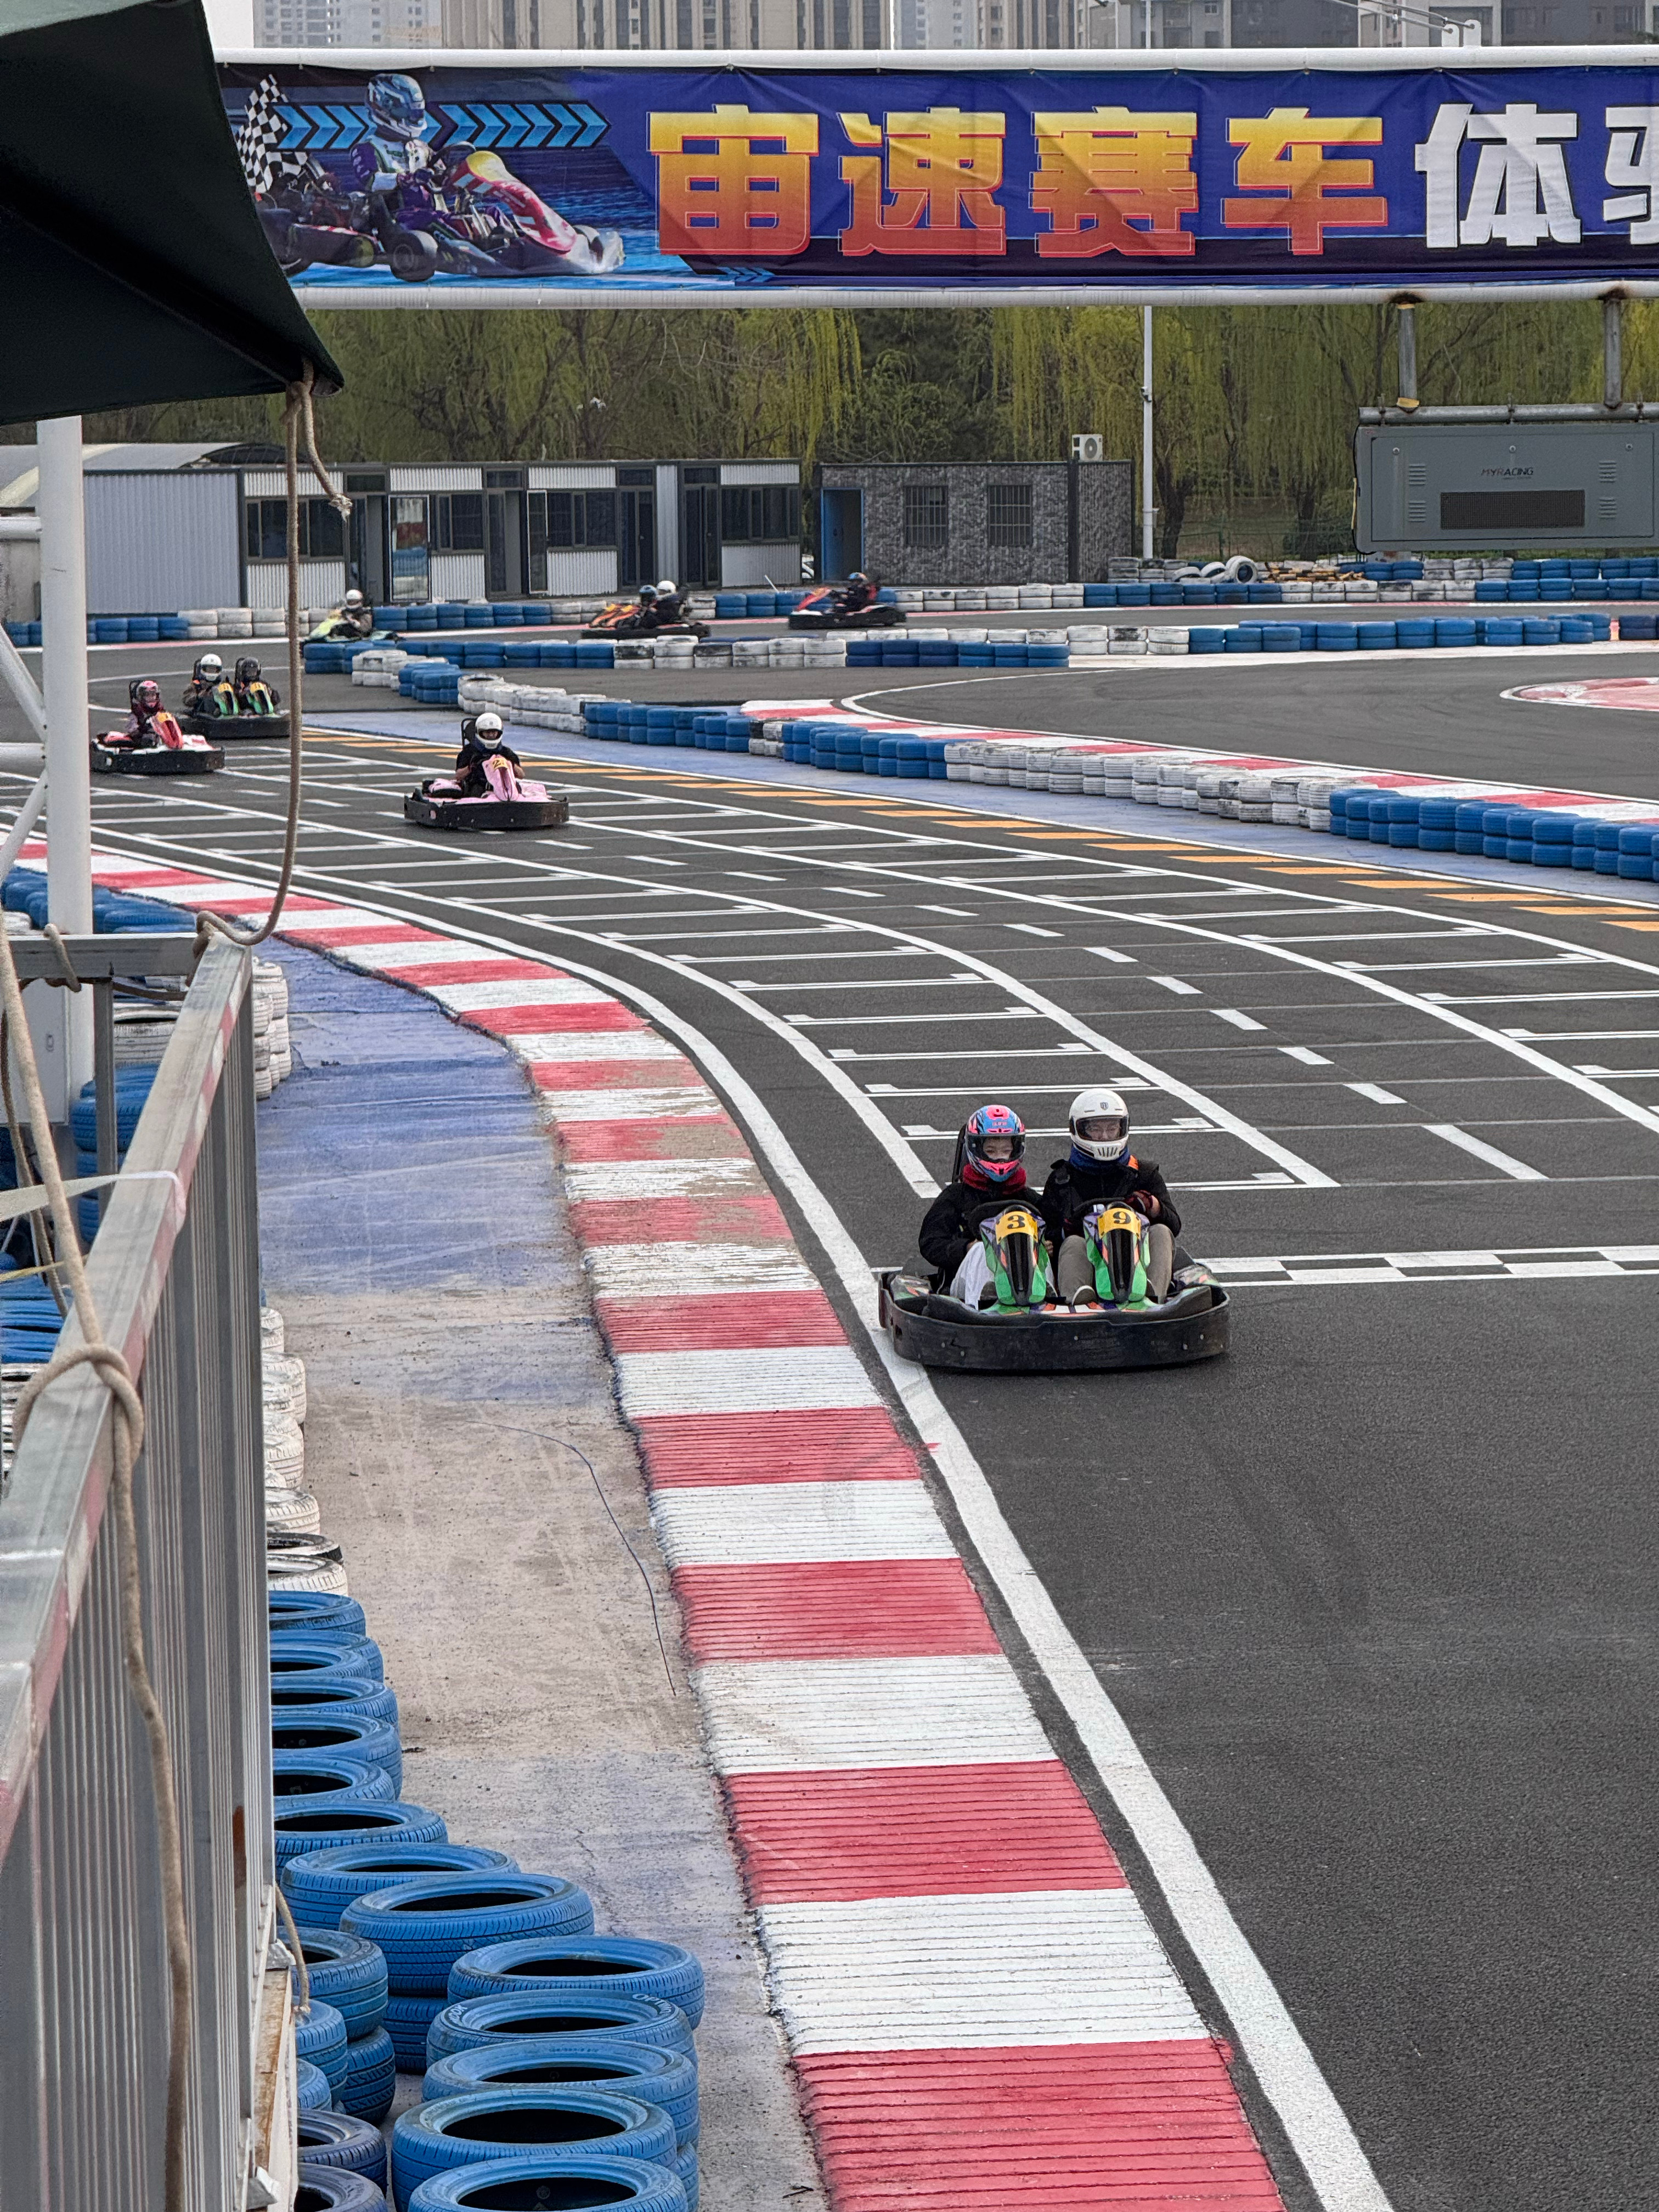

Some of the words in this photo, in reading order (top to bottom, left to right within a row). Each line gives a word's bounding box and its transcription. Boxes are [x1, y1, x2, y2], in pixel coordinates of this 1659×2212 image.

[1481, 467, 1533, 476] MYRACING
[1007, 1215, 1025, 1229] 3
[1113, 1211, 1131, 1224] 9
